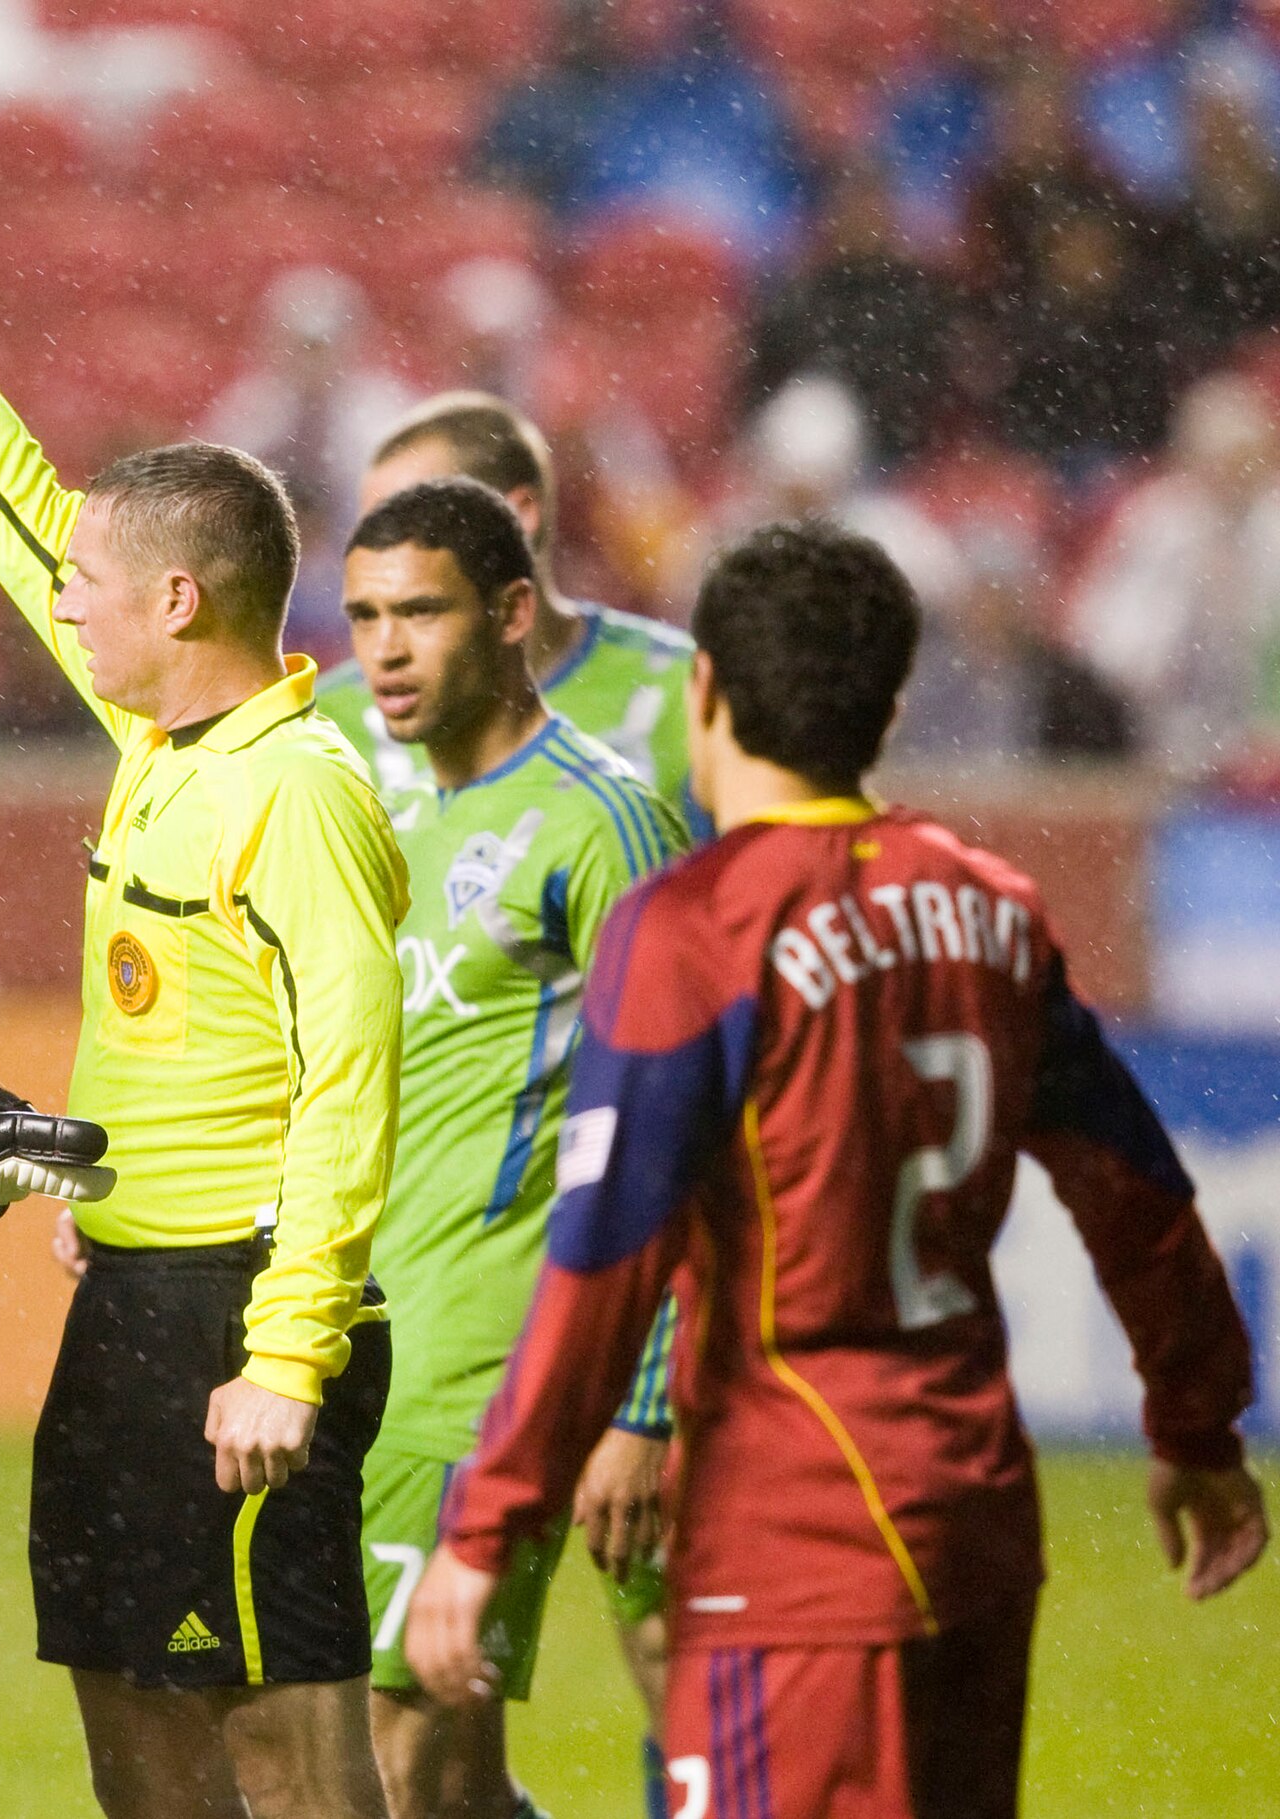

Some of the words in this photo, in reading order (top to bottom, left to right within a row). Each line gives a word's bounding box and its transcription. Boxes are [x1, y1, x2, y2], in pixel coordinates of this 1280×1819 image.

[770, 879, 1032, 1010] BELTRAN
[888, 1031, 996, 1332] 2
[167, 1636, 221, 1653] adidas
[368, 1543, 425, 1652] 7
